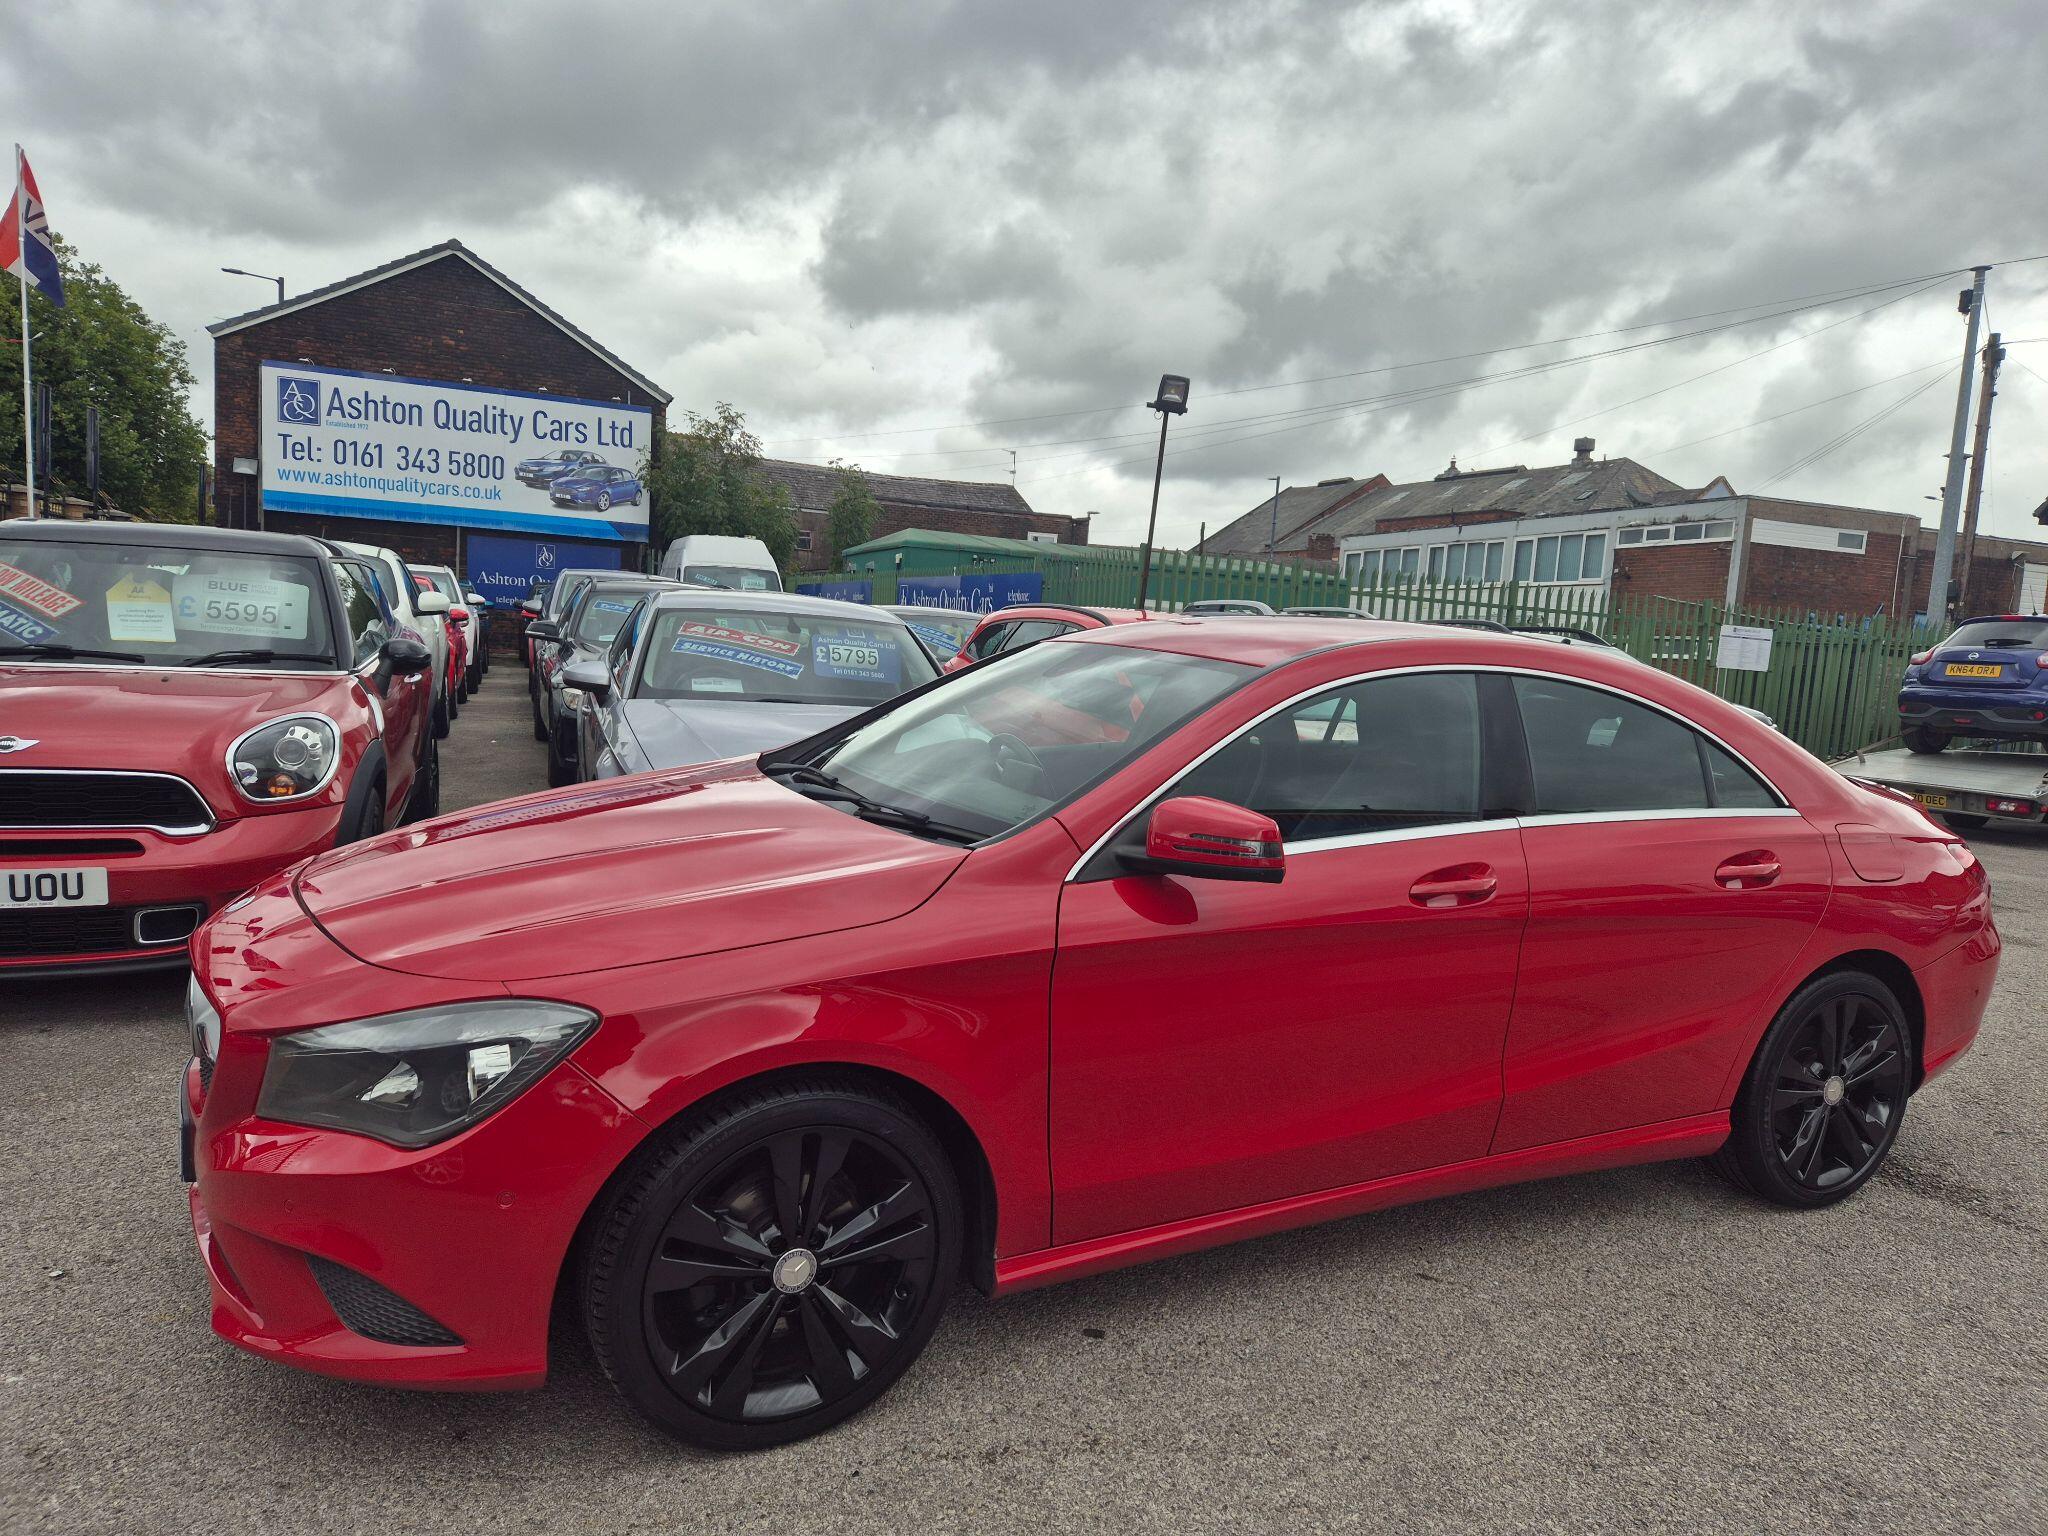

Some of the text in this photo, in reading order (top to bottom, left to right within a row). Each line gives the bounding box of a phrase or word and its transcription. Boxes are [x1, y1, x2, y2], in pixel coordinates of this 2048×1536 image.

[326, 387, 633, 449] Ashton Quality Cars Ltd
[277, 432, 505, 480] Tel: 0161 343 5800
[277, 468, 502, 501] www.ashtonqualitycars.co.uk
[208, 580, 249, 592] BLUE
[477, 570, 526, 587] Ashton
[10, 577, 74, 611] MILEAGE
[911, 588, 938, 607] Ashton
[940, 588, 970, 612] Quality
[971, 587, 993, 614] Cars
[205, 600, 278, 624] 5595
[687, 625, 792, 650] AIR-CON
[818, 636, 843, 645] Ashton
[844, 639, 867, 648] Quality
[868, 641, 884, 649] Cars
[681, 642, 795, 671] SERVICE HISTORY
[831, 647, 878, 666] 5795
[833, 667, 843, 675] Tel
[1949, 665, 1975, 674] KN64
[1925, 795, 1945, 806] OEC
[8, 872, 84, 902] UOU
